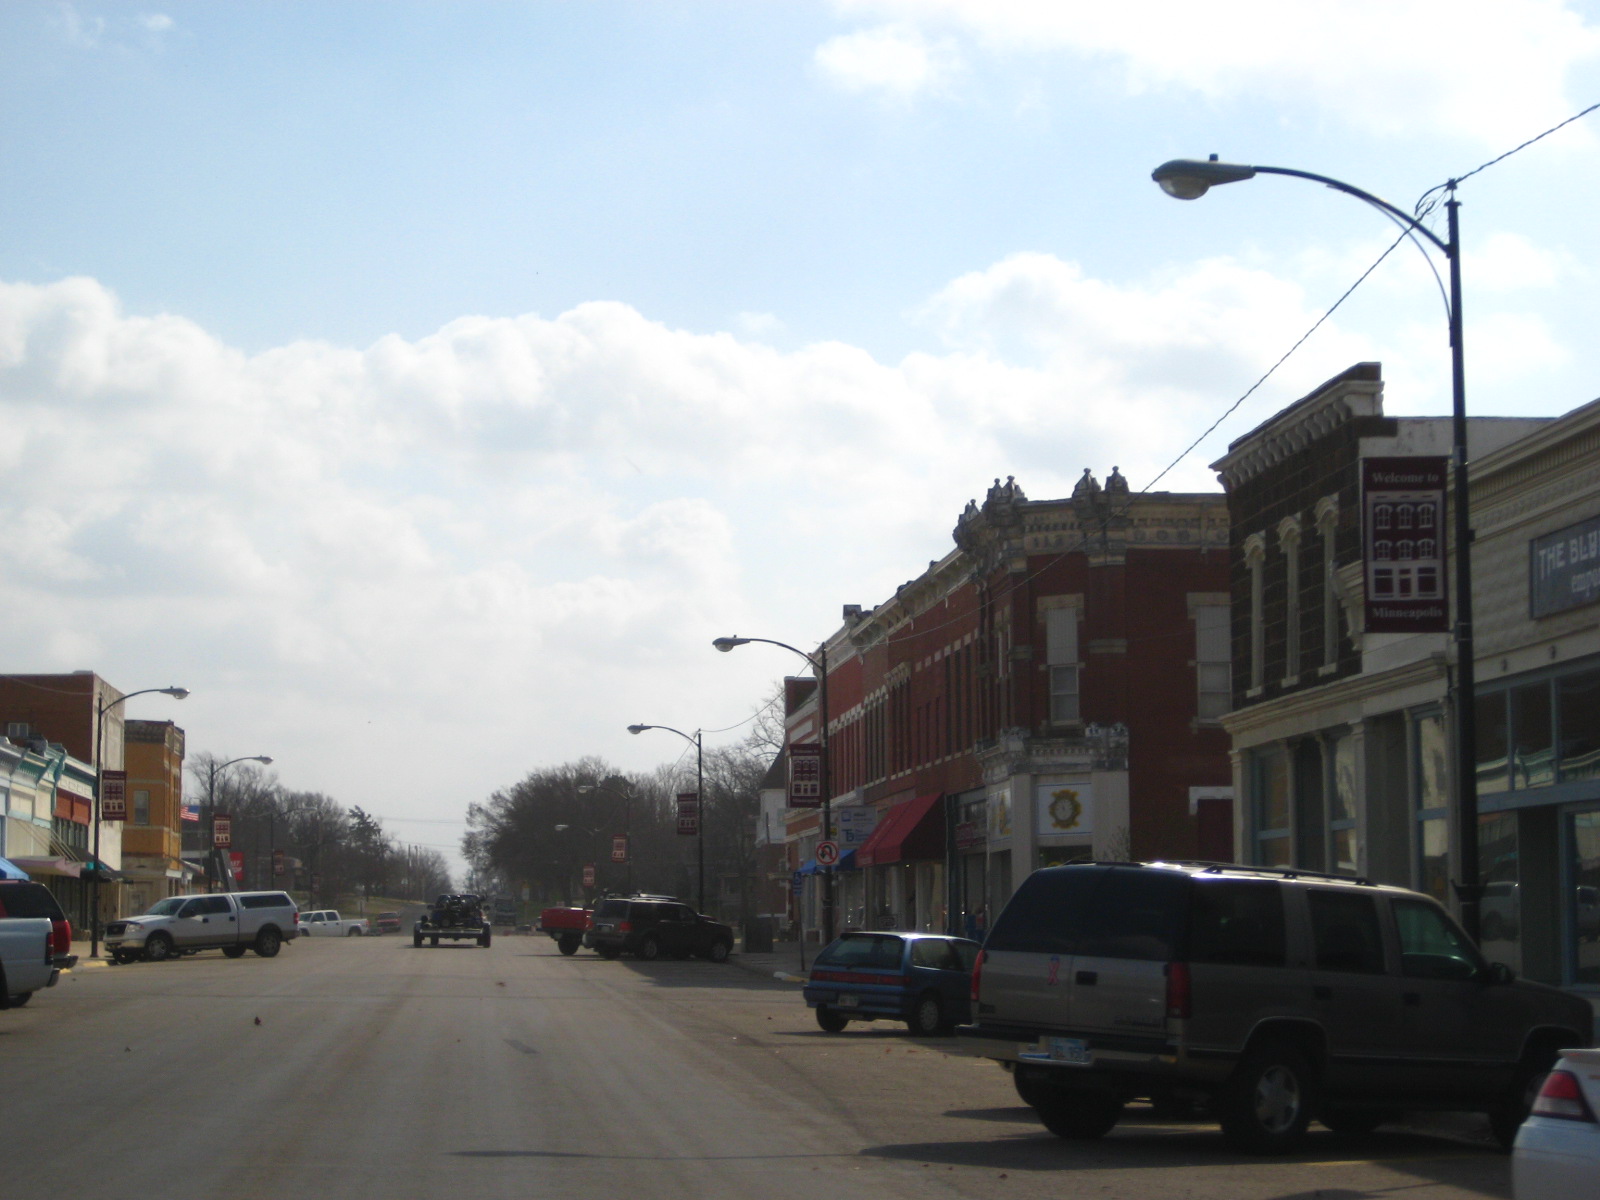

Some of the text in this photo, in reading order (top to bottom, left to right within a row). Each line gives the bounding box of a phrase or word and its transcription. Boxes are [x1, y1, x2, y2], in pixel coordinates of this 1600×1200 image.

[1372, 472, 1440, 484] Welcome to
[1539, 529, 1600, 580] THE BLU
[1372, 606, 1444, 621] Minneapolis
